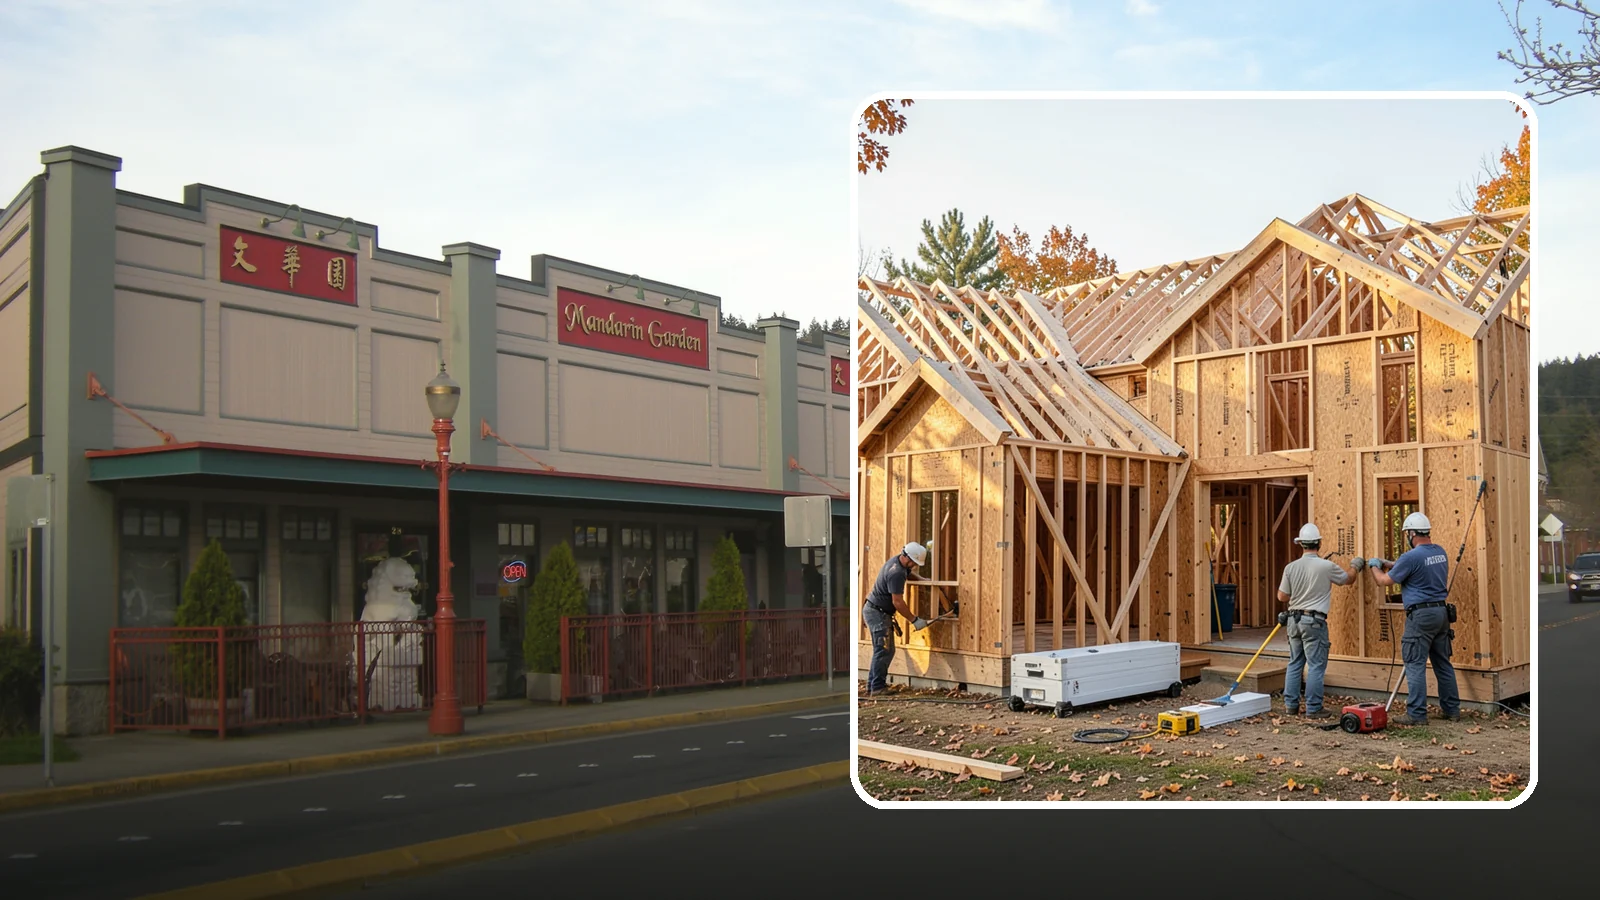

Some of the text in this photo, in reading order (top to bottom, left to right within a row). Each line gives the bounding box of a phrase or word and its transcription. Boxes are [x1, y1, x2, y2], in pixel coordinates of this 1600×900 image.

[564, 302, 702, 352] Mandarin Garden
[835, 363, 847, 386] 文
[503, 565, 527, 578] OPEN
